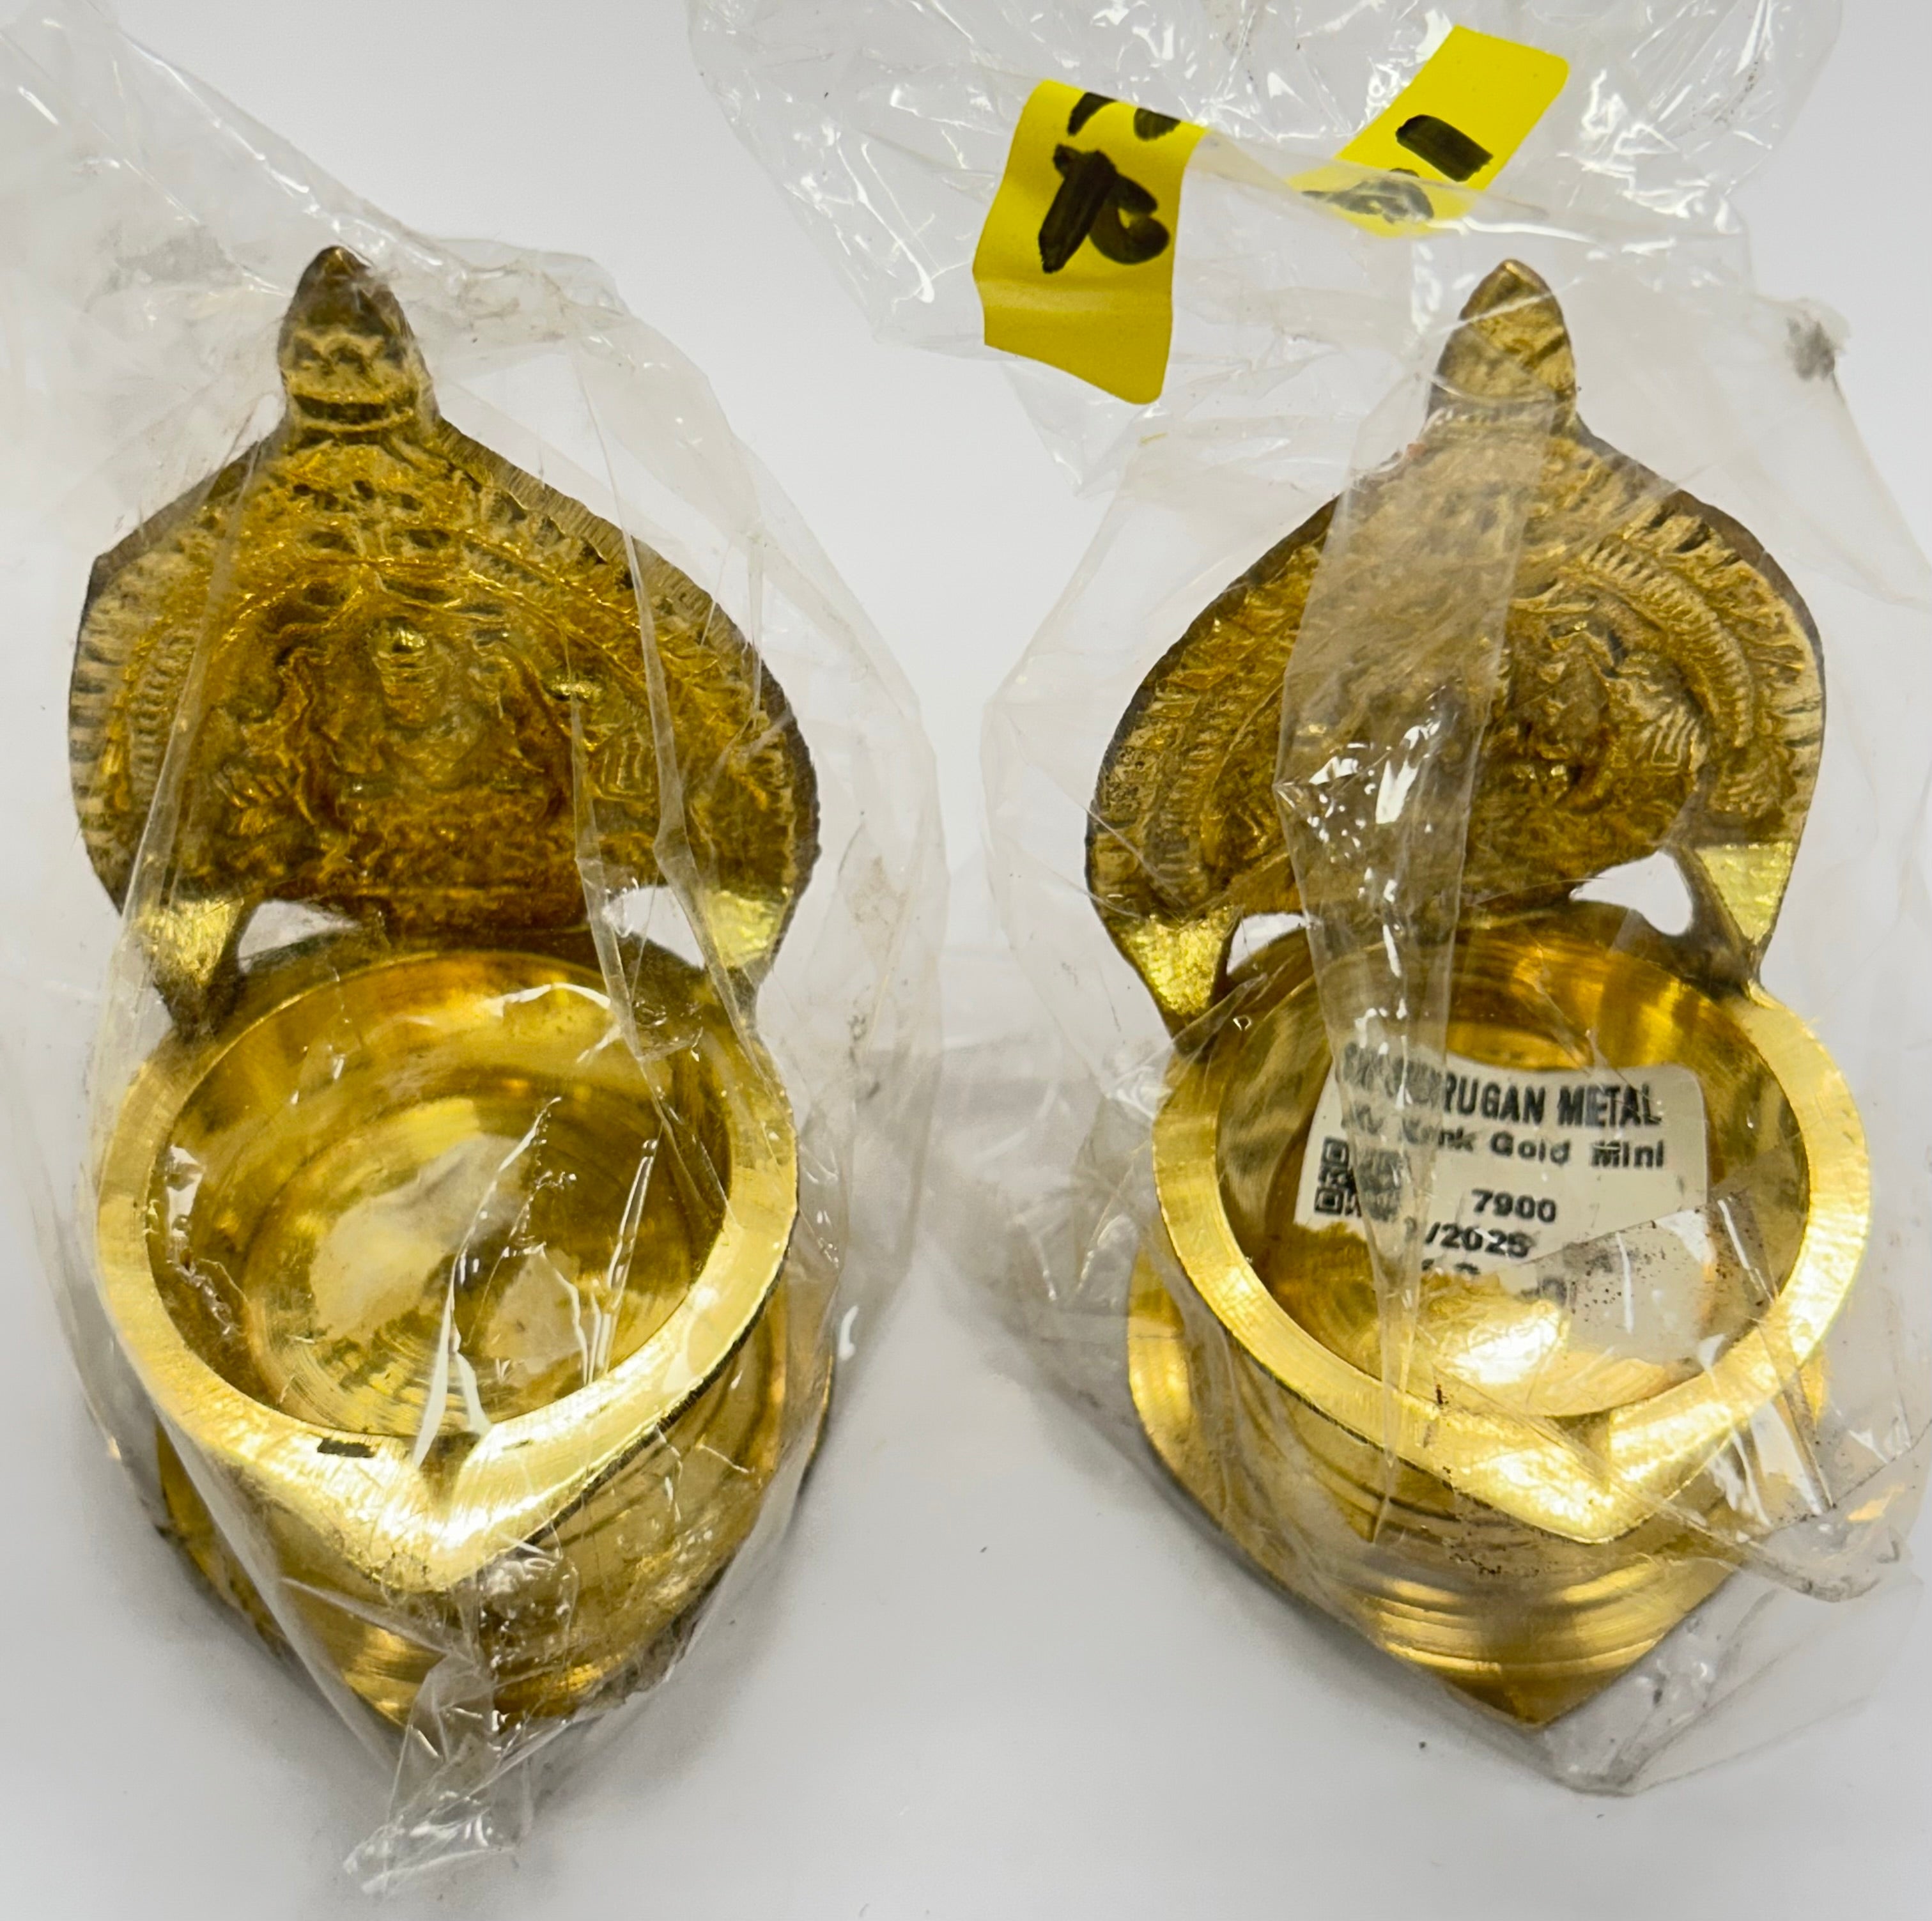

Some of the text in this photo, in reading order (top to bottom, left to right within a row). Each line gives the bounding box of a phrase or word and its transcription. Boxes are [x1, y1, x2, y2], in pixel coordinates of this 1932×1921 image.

[1557, 1083, 1662, 1127] METAL
[1490, 1130, 1570, 1168] Gold
[1590, 1139, 1665, 1168] Mini
[1472, 1188, 1557, 1223] 7900
